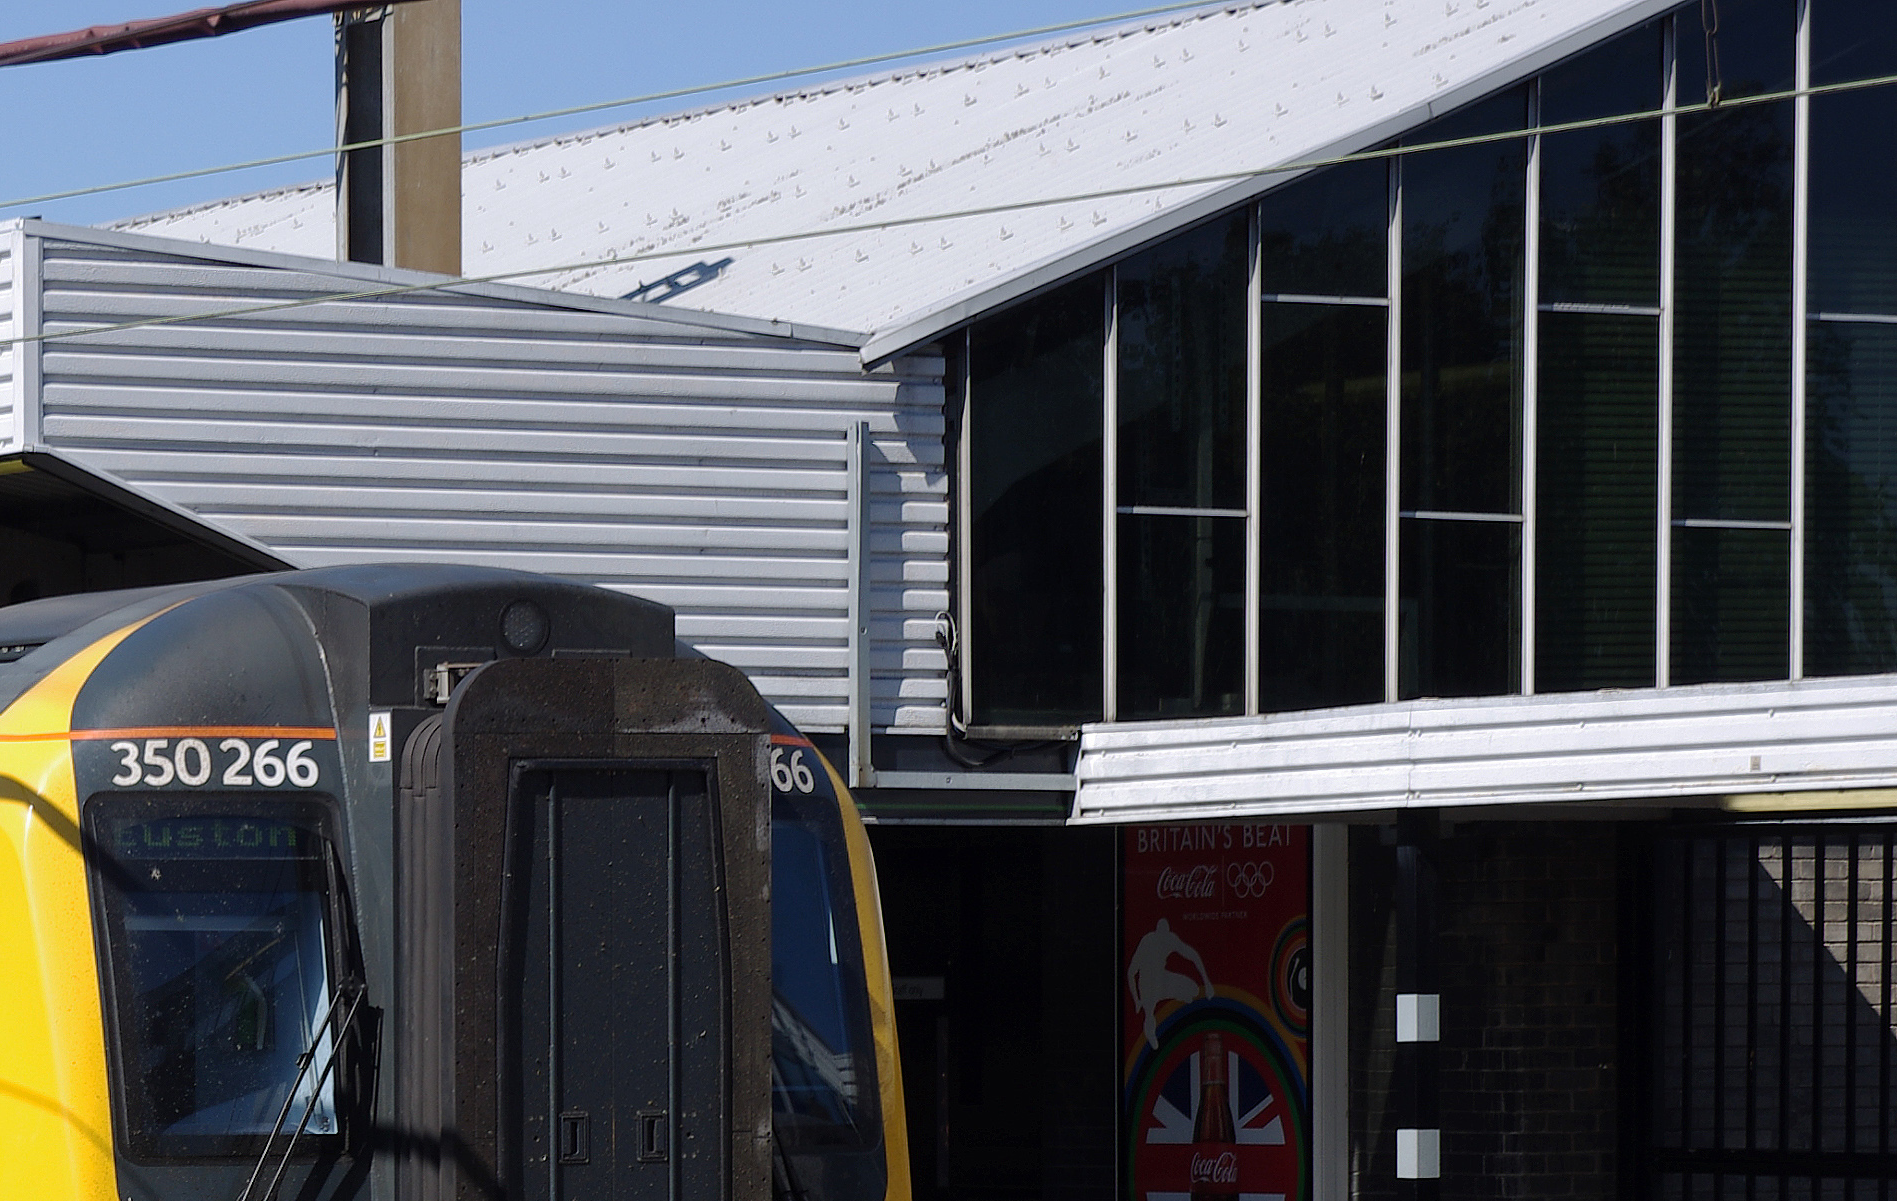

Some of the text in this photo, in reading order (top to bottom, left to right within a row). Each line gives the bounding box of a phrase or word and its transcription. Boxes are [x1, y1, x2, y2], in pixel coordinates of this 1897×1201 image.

[110, 738, 319, 788] 350 266
[770, 747, 815, 794] 66
[1138, 825, 1232, 853] BRITAIN'S
[1157, 865, 1217, 899] Coca-Cola
[1190, 1152, 1238, 1183] Coca-Cola
